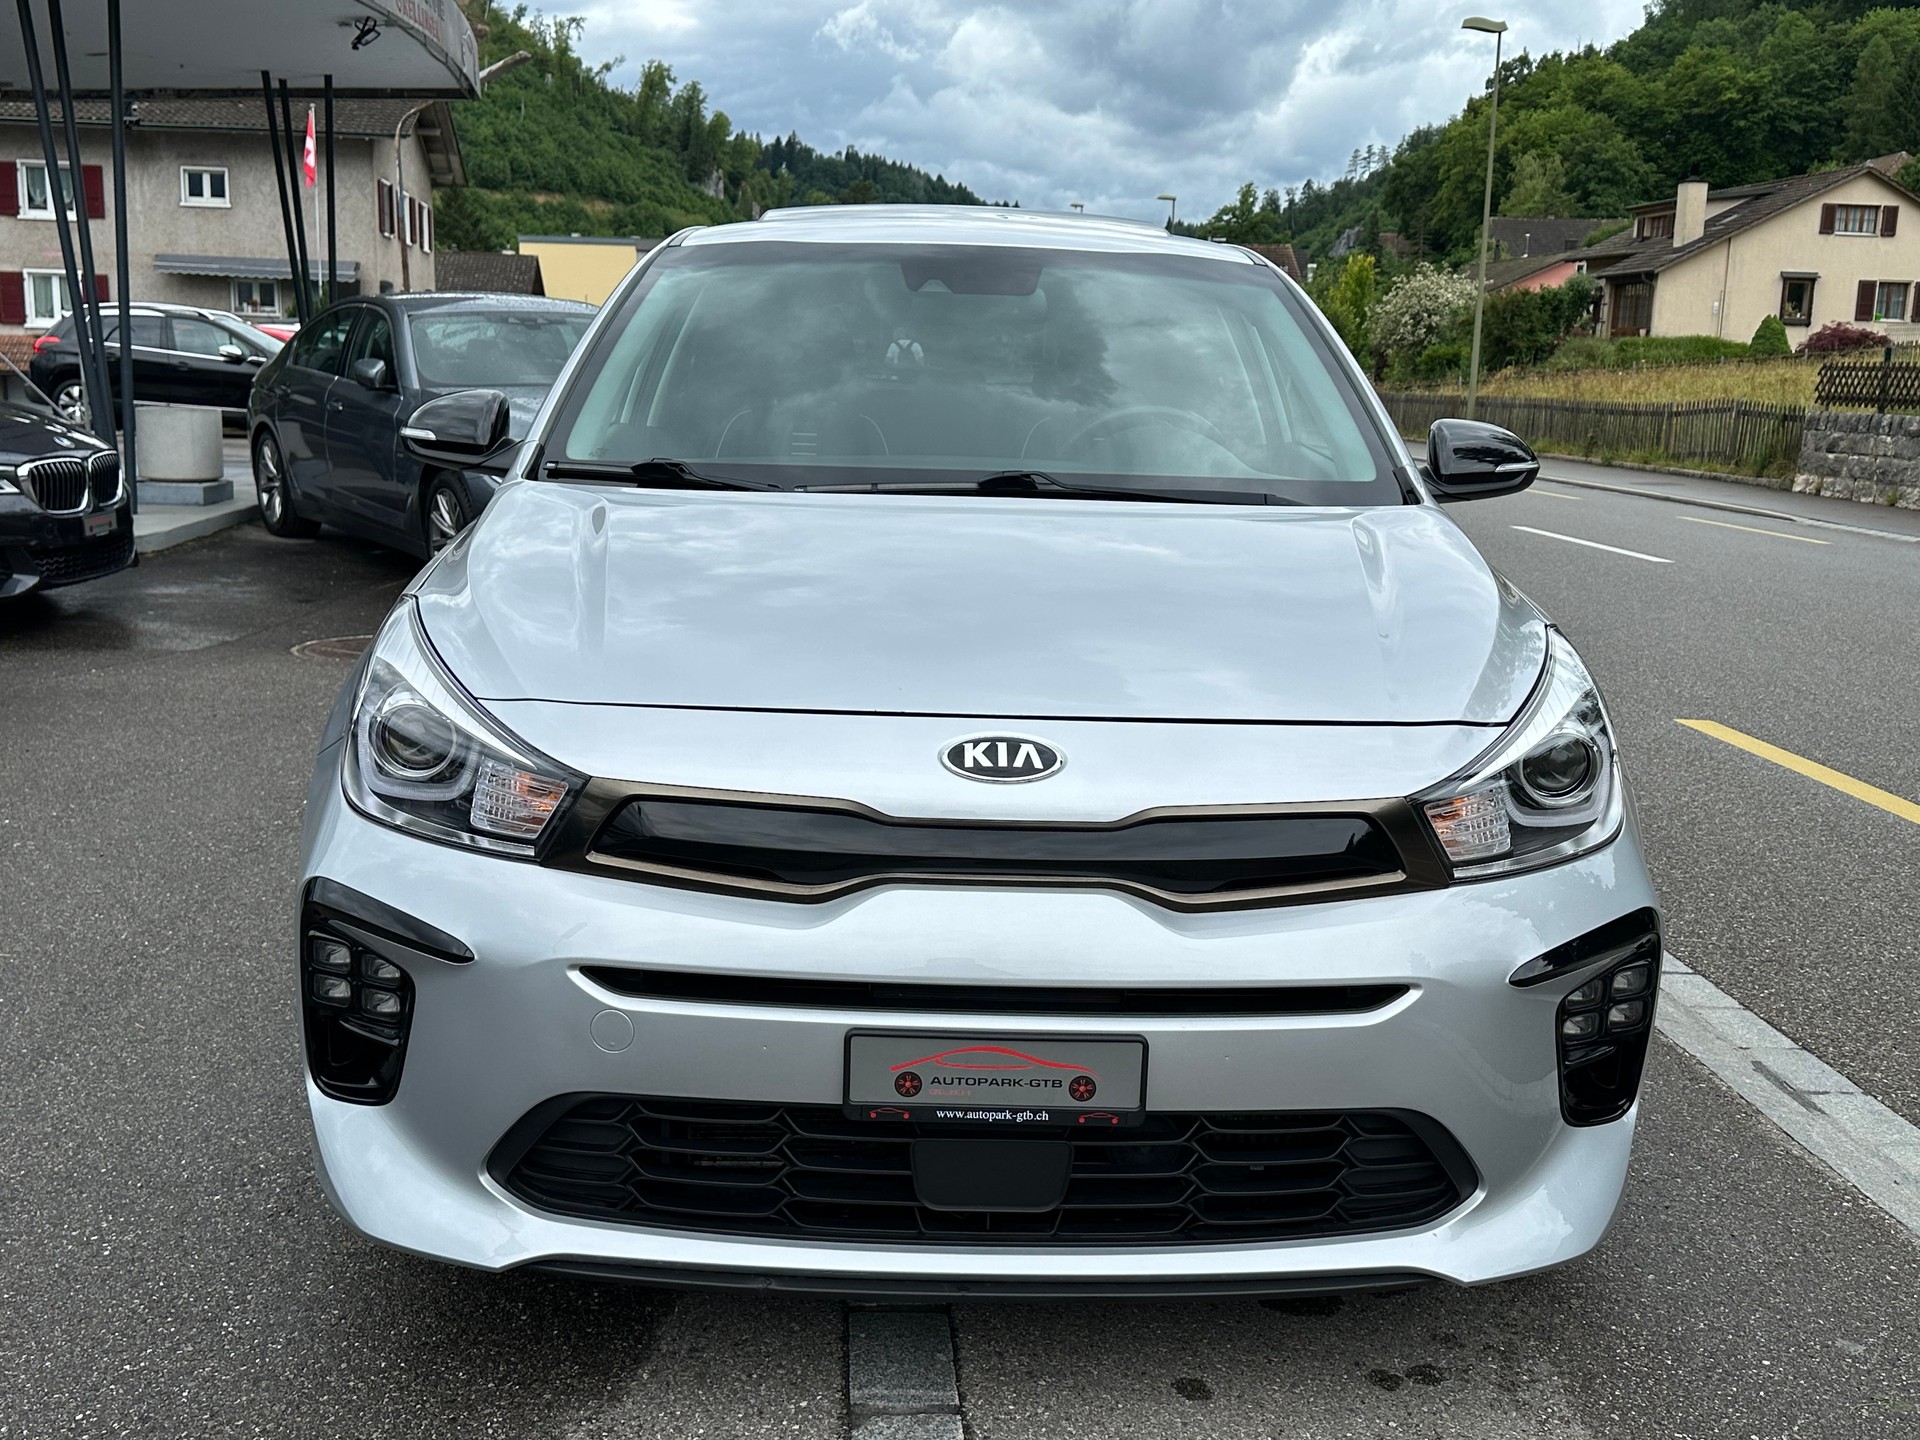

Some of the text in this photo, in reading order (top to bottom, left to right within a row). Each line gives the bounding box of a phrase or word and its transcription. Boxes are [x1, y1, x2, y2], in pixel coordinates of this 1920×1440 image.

[962, 741, 1044, 769] KIA
[930, 1076, 1063, 1089] AUTOPARK-GTB
[936, 1109, 1049, 1122] www.autopark-gtb.ch
